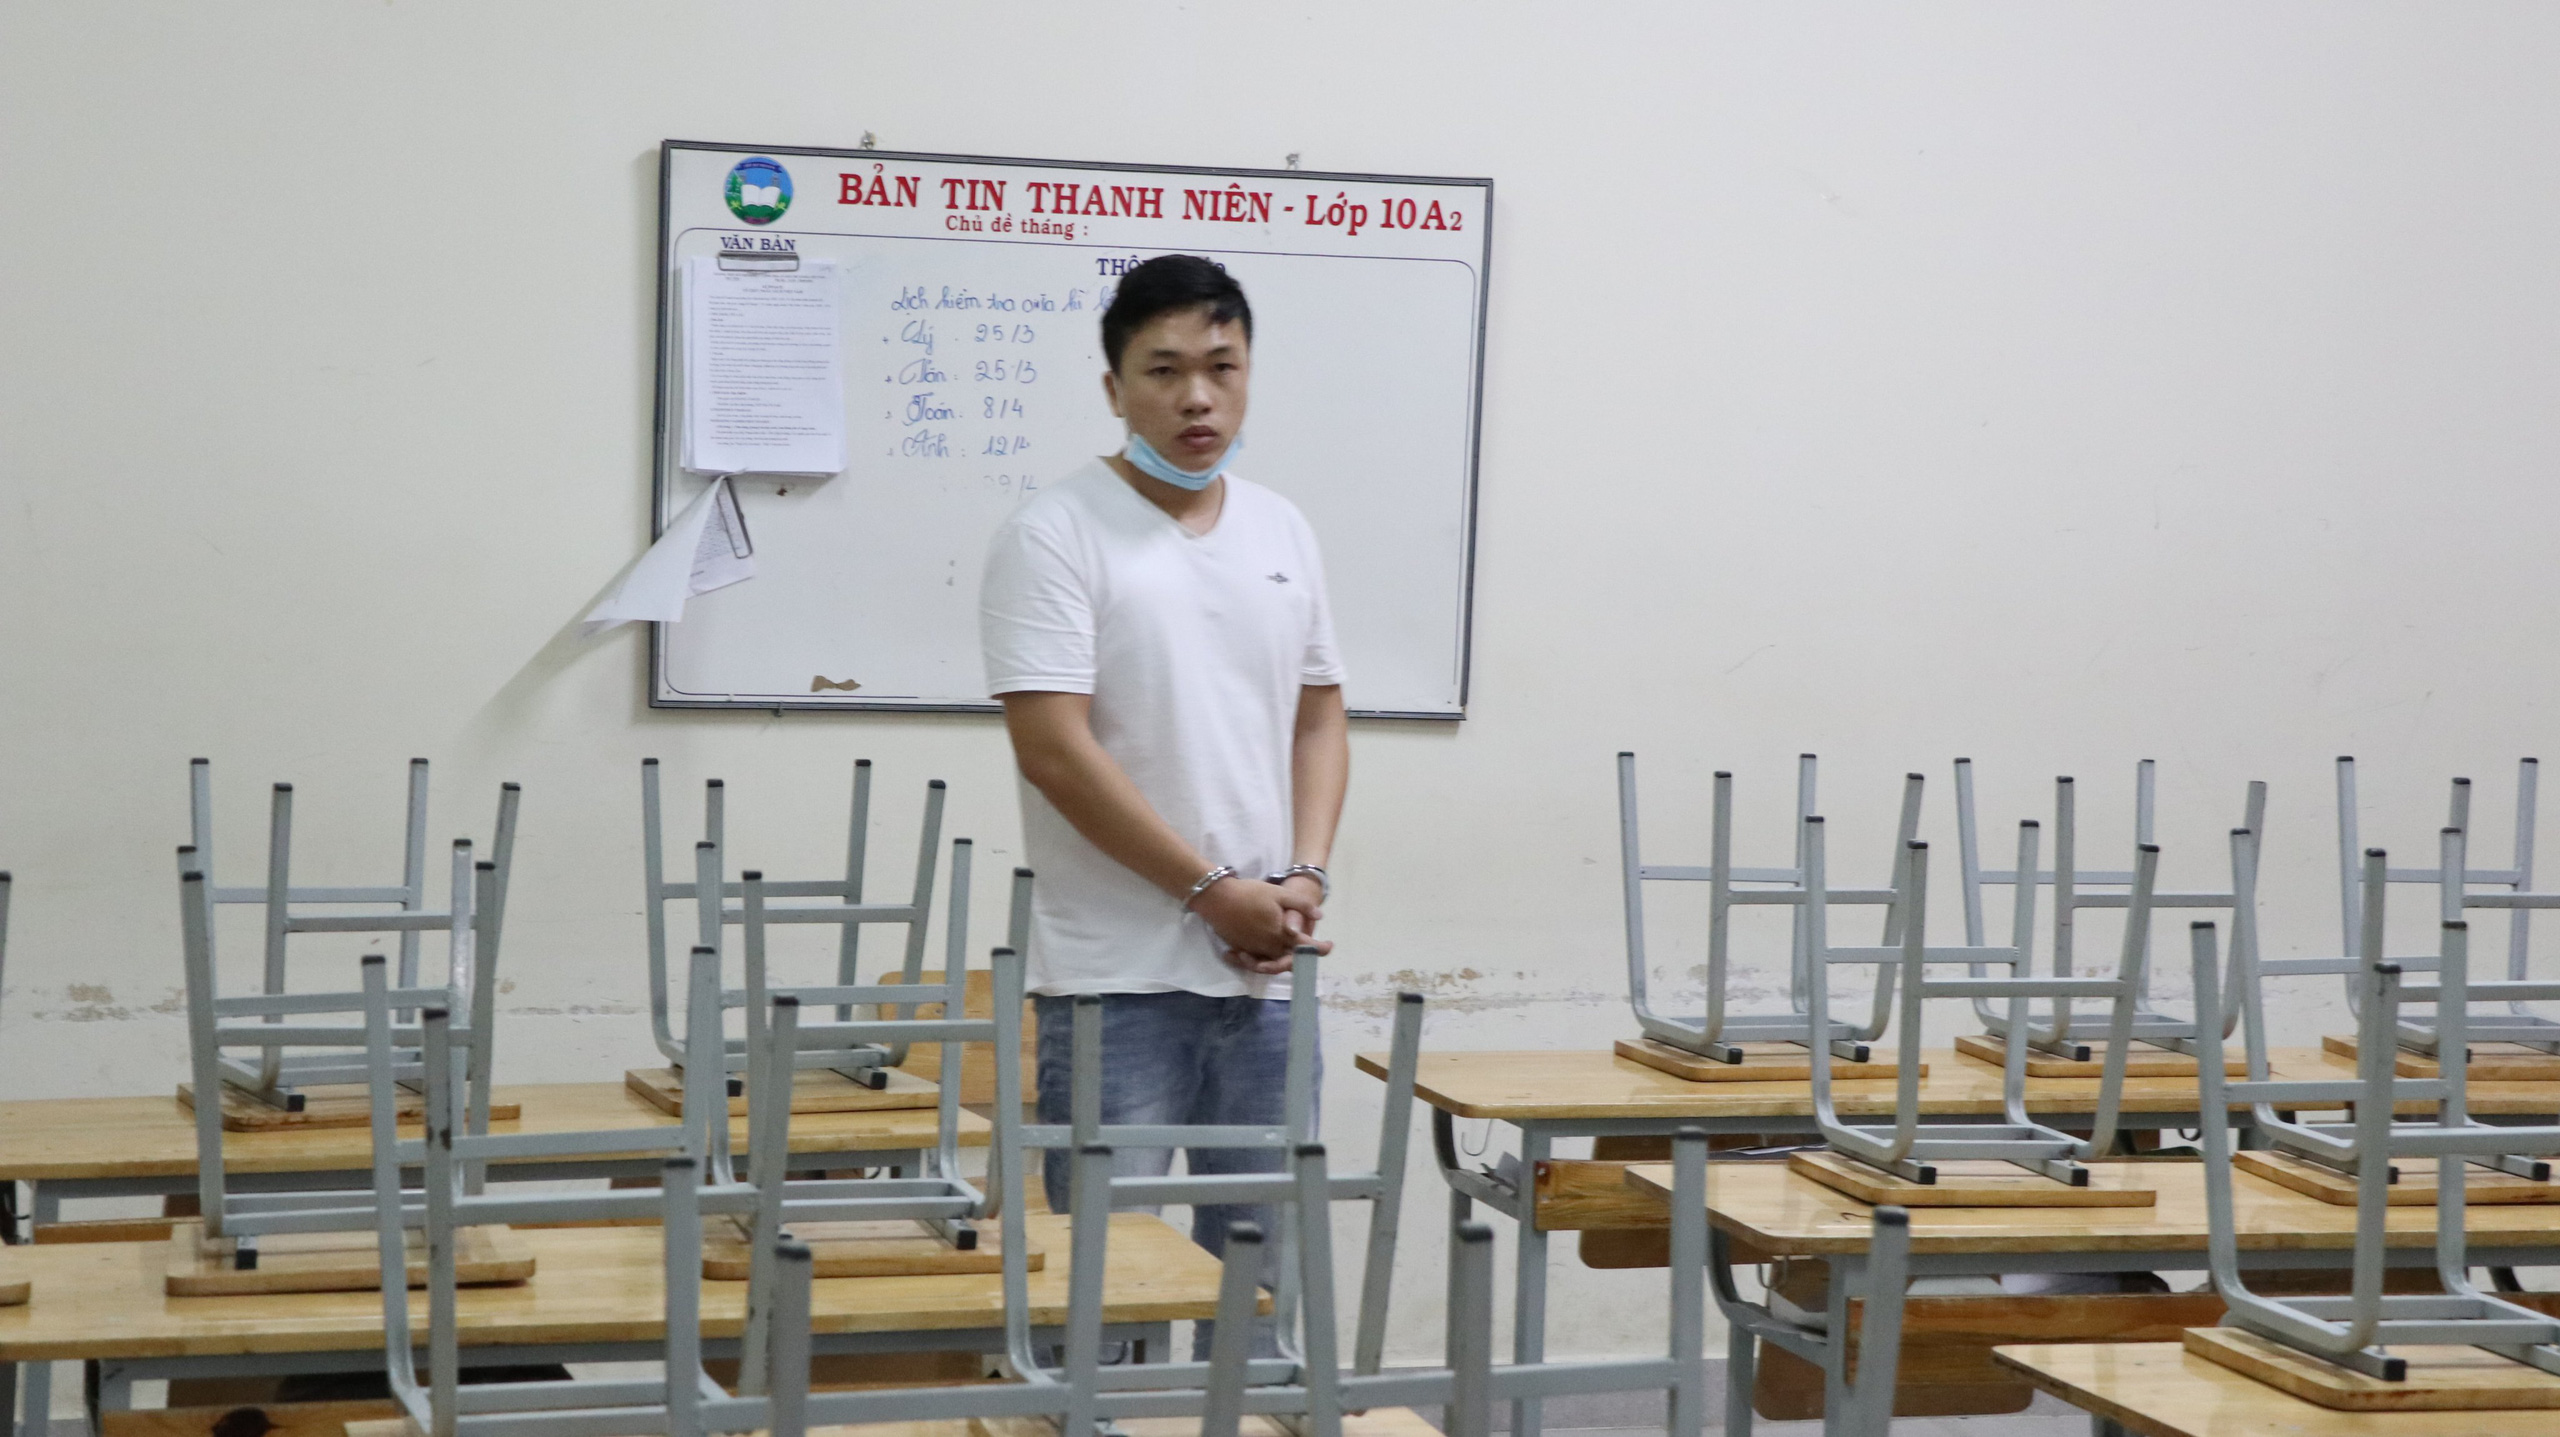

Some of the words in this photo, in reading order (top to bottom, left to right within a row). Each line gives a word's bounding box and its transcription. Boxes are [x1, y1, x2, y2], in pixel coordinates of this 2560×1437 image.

[838, 163, 921, 207] BẢN
[940, 178, 1007, 211] TIN
[1026, 182, 1165, 219] THANH
[1182, 183, 1273, 223] NIÊN
[1304, 192, 1368, 236] Lớp
[945, 214, 983, 232] Chủ
[991, 213, 1013, 233] đề
[1021, 218, 1075, 240] tháng
[720, 234, 754, 250] VĂN
[760, 234, 796, 251] BẢN
